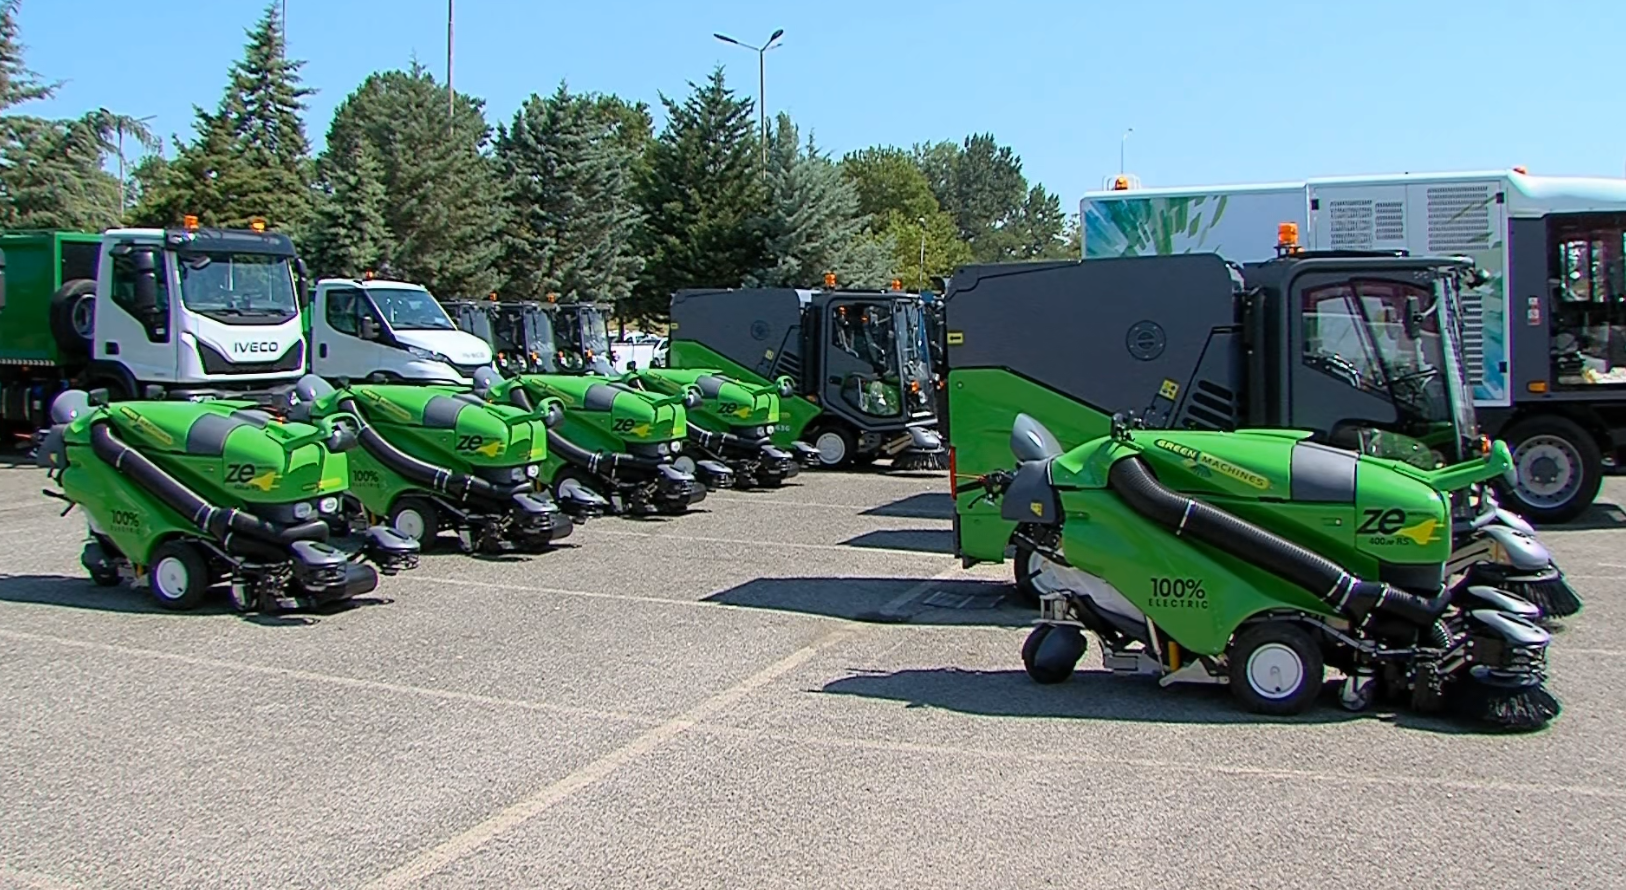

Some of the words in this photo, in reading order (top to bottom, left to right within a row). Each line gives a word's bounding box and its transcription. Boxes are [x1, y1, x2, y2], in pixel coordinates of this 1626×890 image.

[234, 341, 279, 353] IVECO
[1157, 440, 1197, 459] GREEN
[1201, 455, 1264, 487] MACHINES
[352, 469, 380, 483] 100%
[111, 509, 140, 528] 100%
[1356, 508, 1406, 535] ze
[1150, 577, 1206, 600] 100%
[1148, 598, 1209, 610] ELECTRIC
